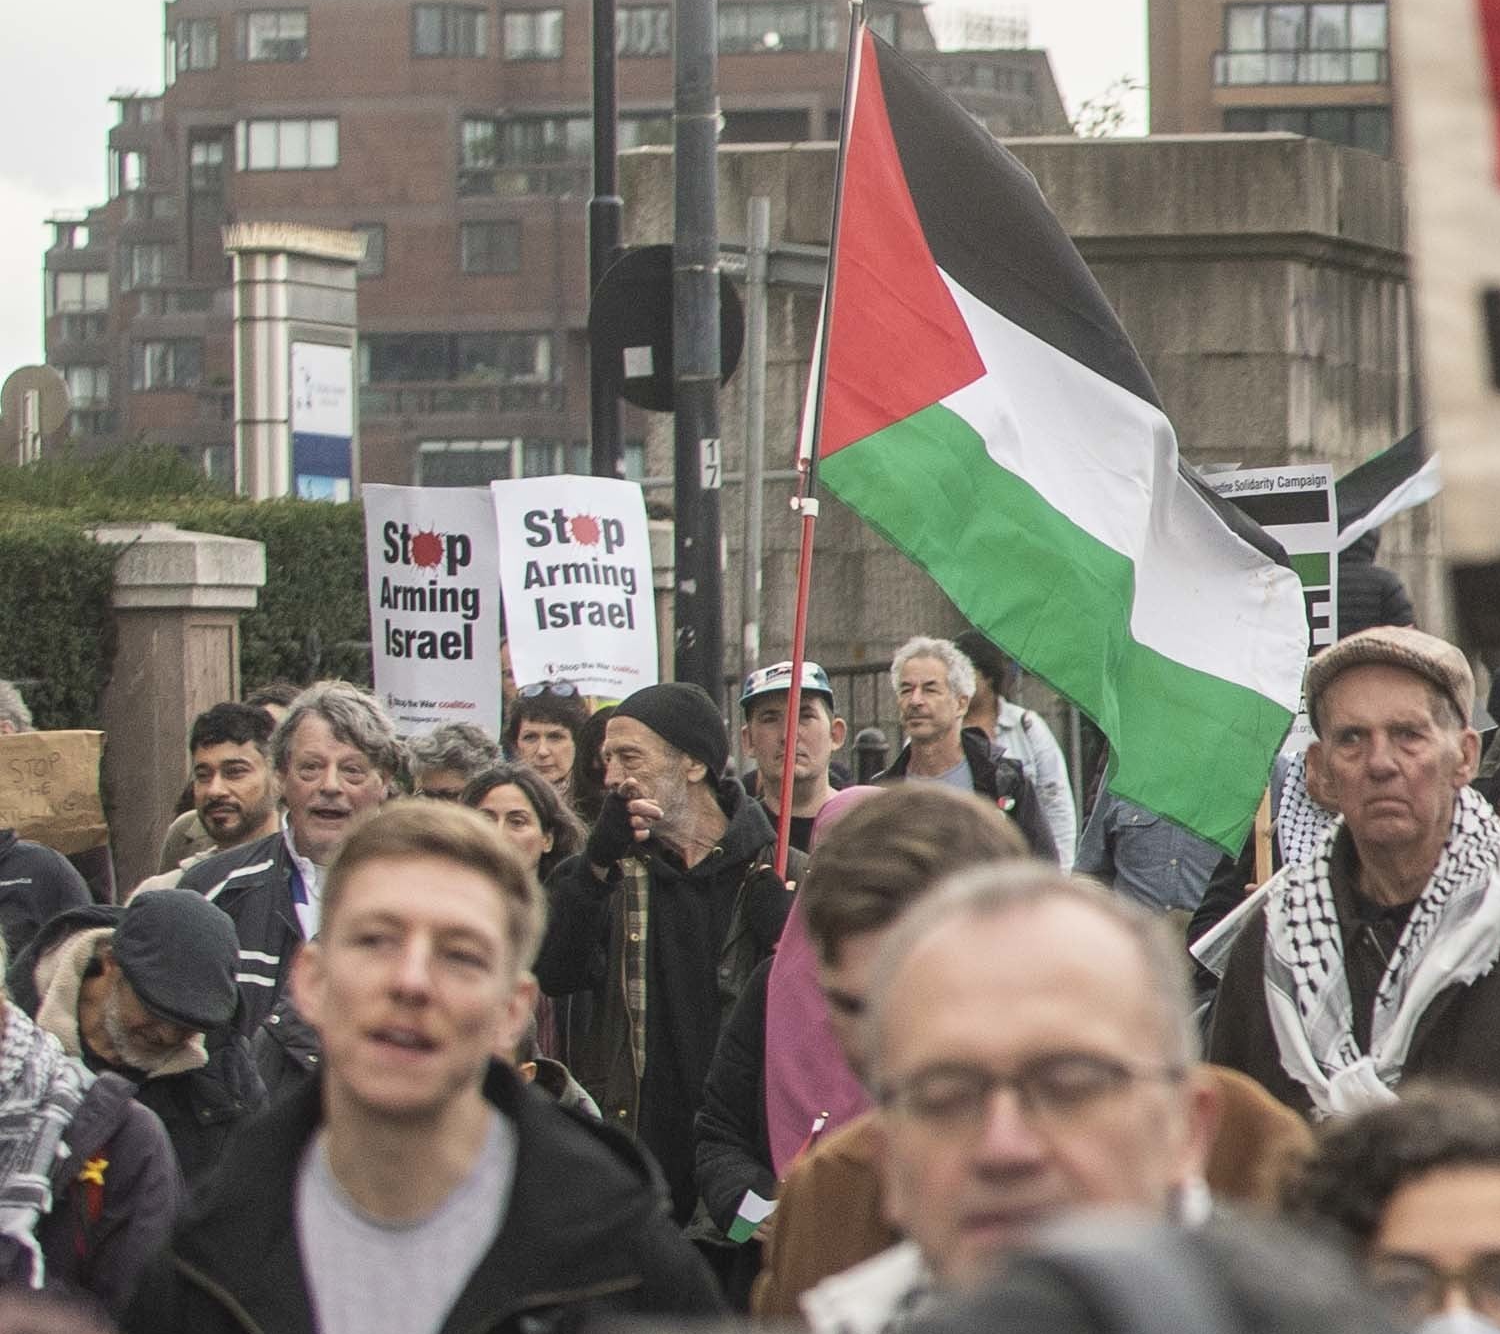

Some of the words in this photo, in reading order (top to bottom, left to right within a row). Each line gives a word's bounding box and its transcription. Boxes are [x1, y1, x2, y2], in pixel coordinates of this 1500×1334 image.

[1234, 478, 1275, 492] Solidarity
[1276, 474, 1328, 491] Campaign
[383, 520, 472, 576] Stop
[523, 508, 625, 554] Stop
[523, 557, 638, 595] Arming
[380, 575, 480, 620] Arming
[534, 597, 636, 631] Israel
[384, 618, 473, 660] Israel
